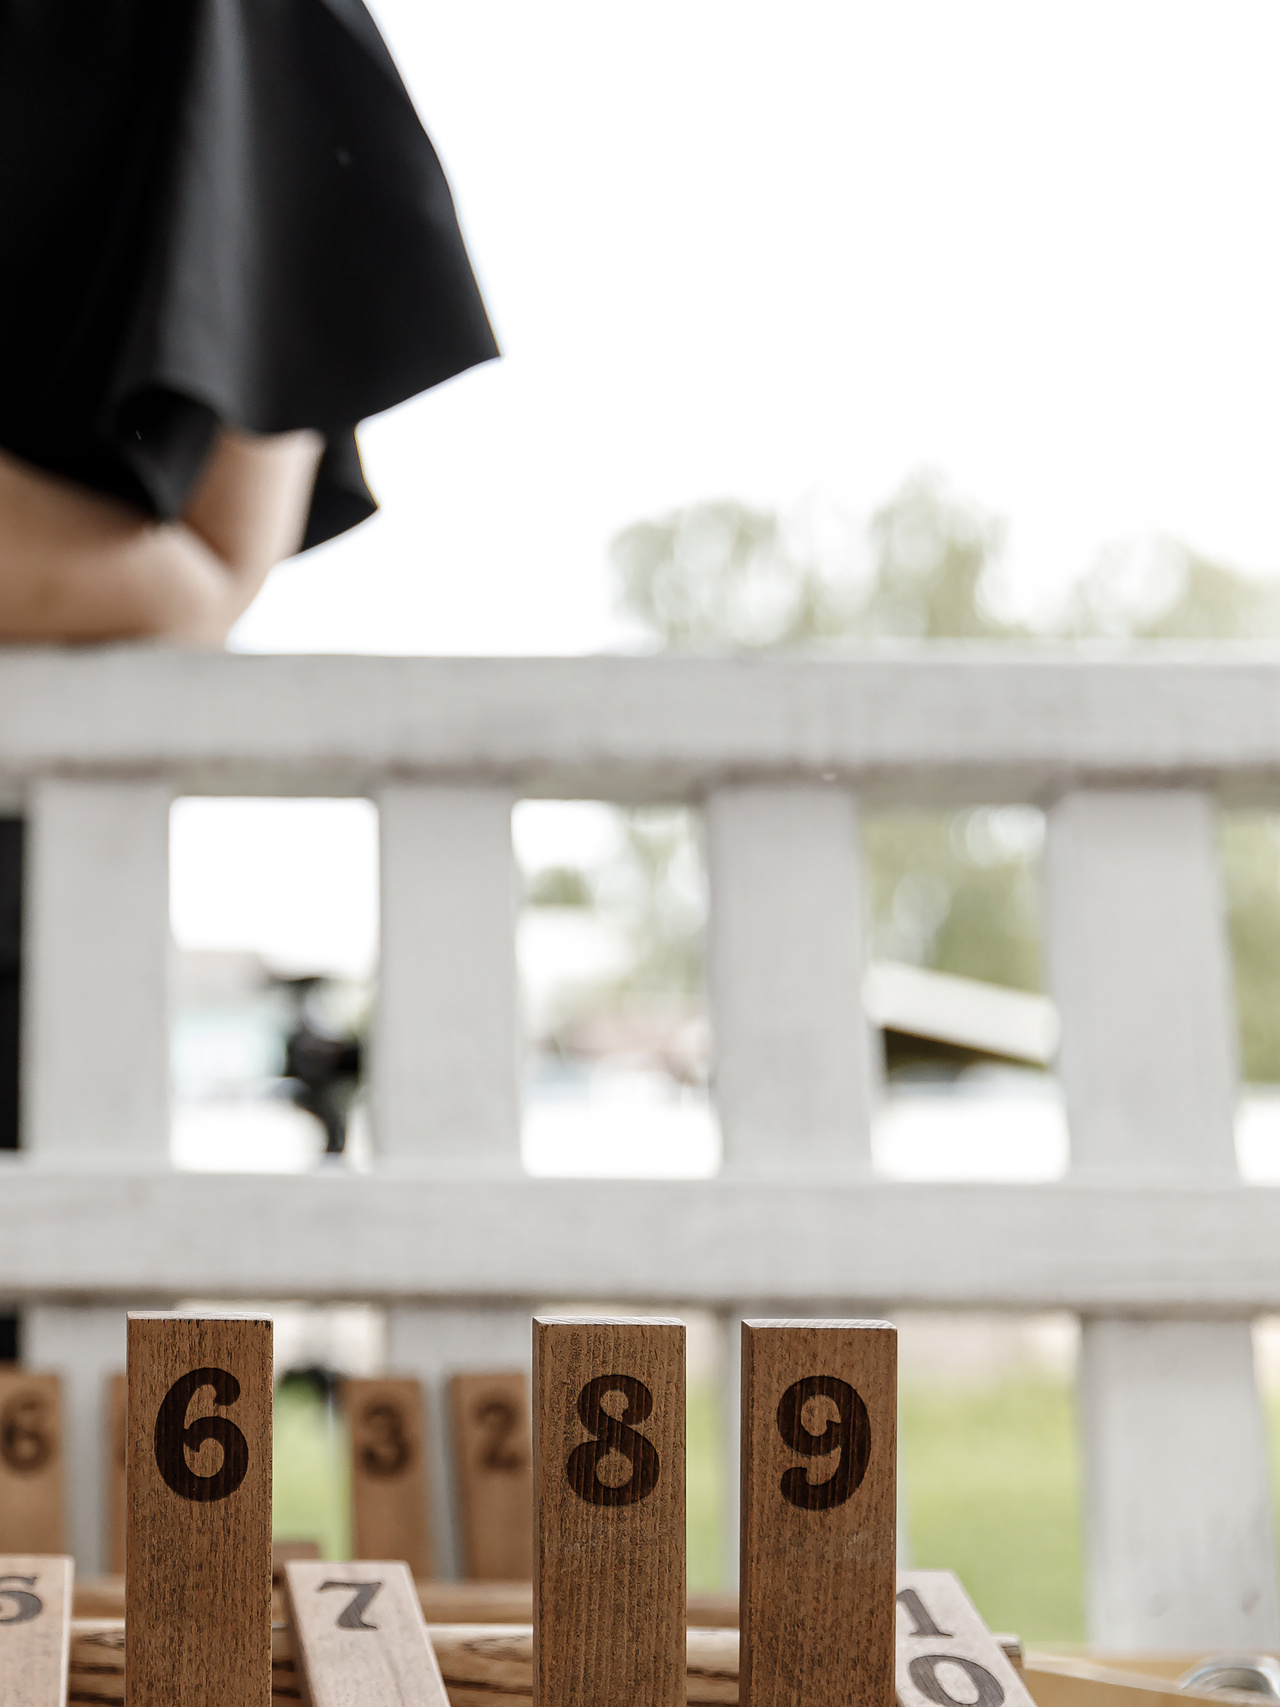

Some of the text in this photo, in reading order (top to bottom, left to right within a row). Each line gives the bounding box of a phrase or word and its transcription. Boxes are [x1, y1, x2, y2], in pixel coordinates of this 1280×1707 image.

[0, 1396, 52, 1474] 6
[154, 1367, 249, 1503] 6
[361, 1402, 414, 1480] 3
[476, 1398, 526, 1473] 2
[567, 1374, 660, 1506] 8
[776, 1375, 872, 1511] 9
[317, 1579, 383, 1632] 7
